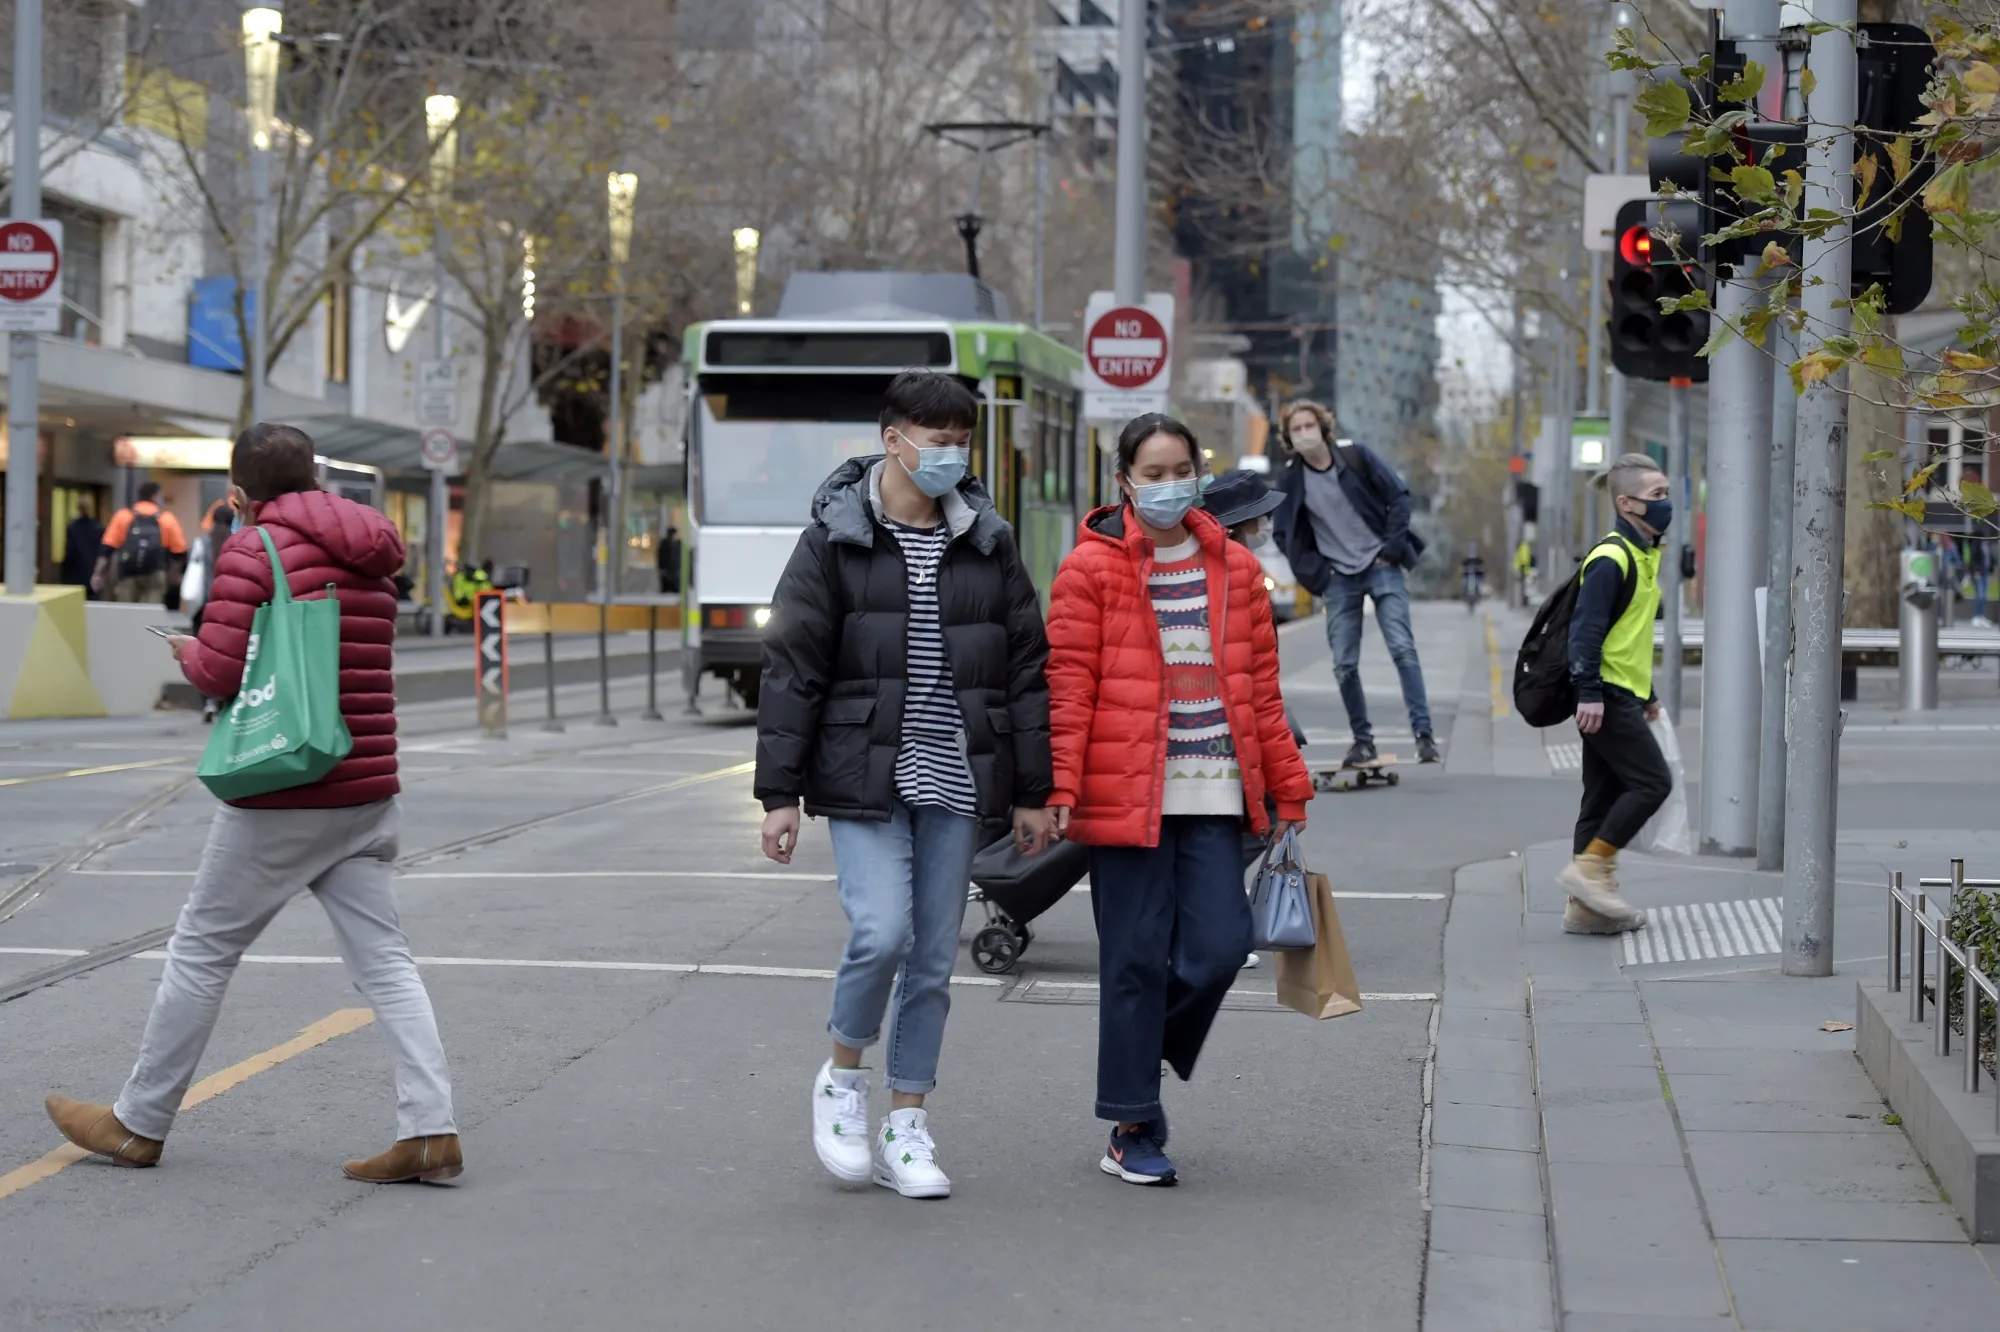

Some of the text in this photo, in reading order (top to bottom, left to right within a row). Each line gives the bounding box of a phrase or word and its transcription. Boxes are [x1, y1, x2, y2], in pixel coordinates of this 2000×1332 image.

[7, 233, 35, 251] NO
[0, 271, 48, 288] NTRY
[1114, 319, 1142, 337] NO
[1098, 358, 1157, 377] ENTRY
